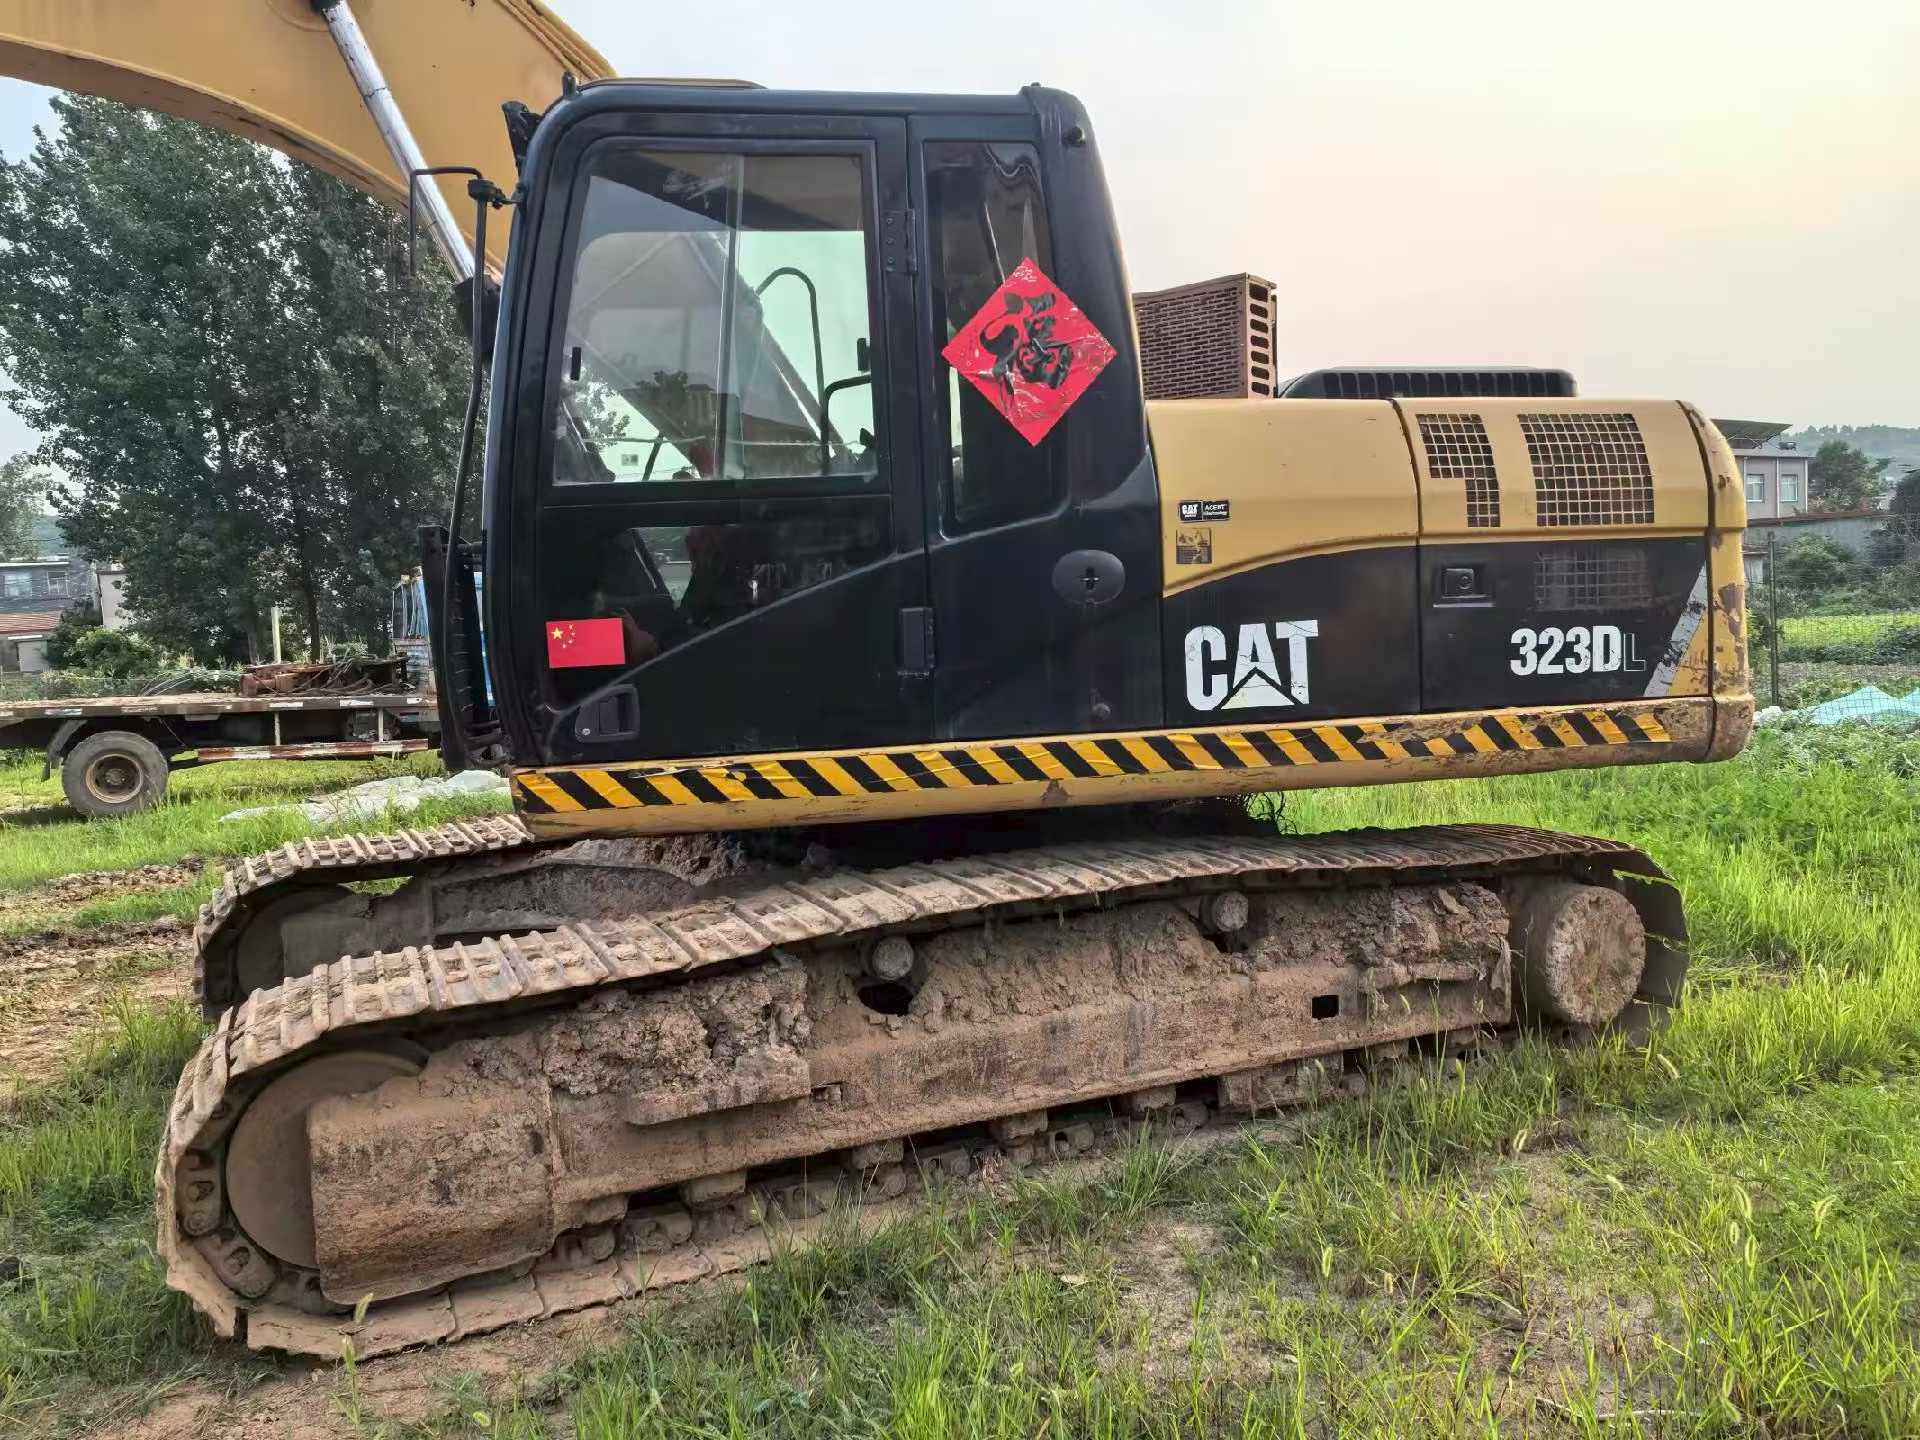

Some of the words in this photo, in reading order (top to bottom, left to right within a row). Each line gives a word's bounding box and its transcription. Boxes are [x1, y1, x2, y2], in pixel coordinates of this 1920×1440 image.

[979, 291, 1073, 395] 福
[1181, 504, 1199, 515] CAT
[1185, 619, 1319, 711] CAT
